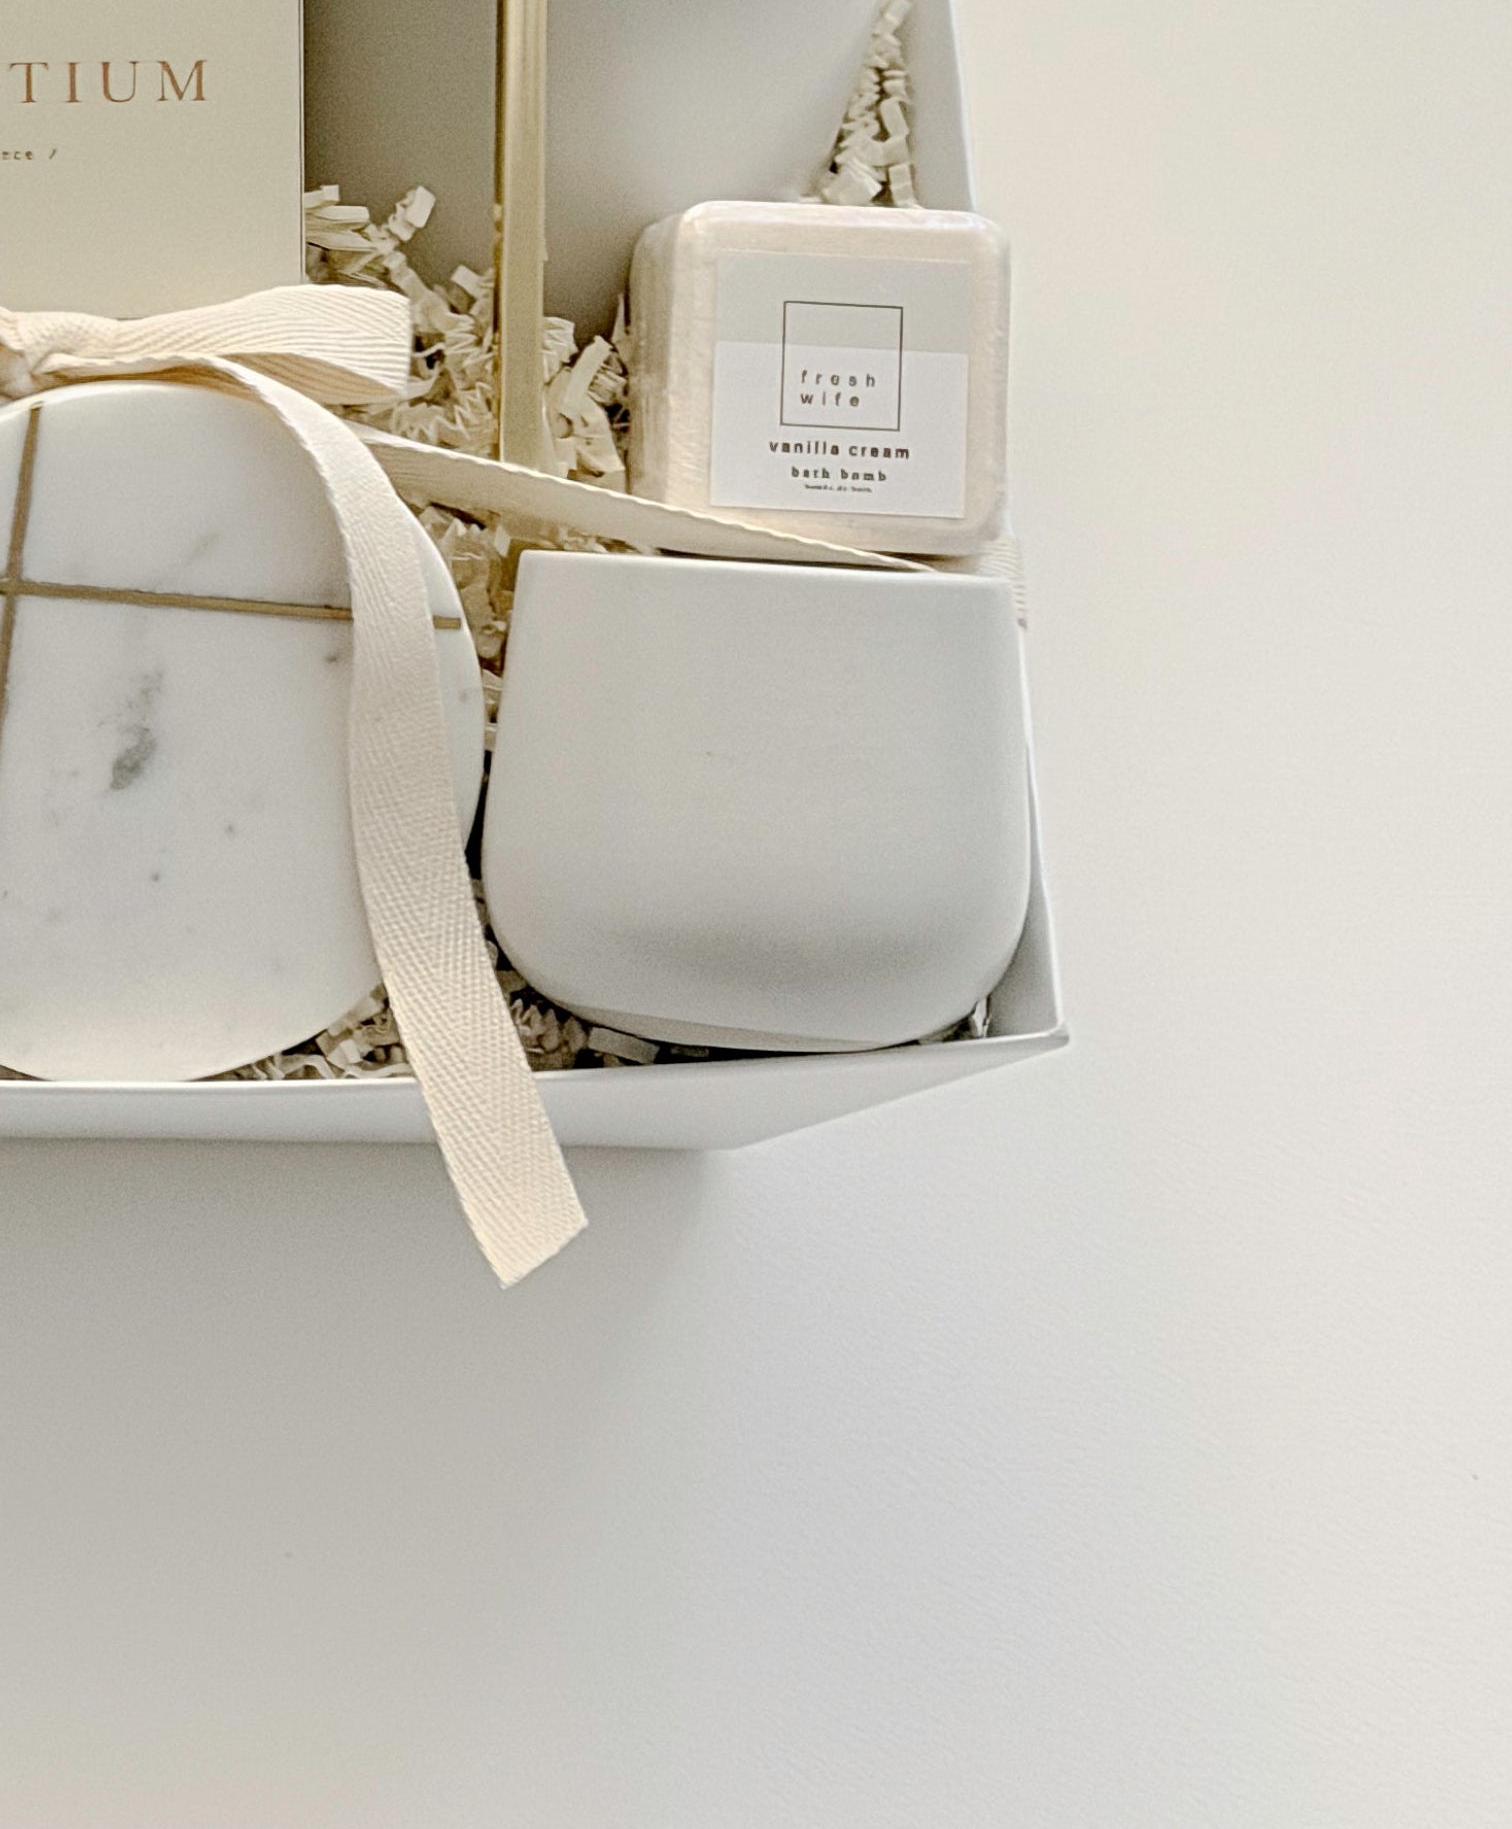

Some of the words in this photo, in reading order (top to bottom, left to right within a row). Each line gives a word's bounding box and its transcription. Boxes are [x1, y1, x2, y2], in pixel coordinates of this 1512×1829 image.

[801, 369, 876, 388] fresh
[800, 391, 860, 407] wife
[769, 440, 840, 456] vanilla
[848, 445, 910, 460] cream
[791, 466, 831, 479] bath
[840, 468, 887, 482] bomb
